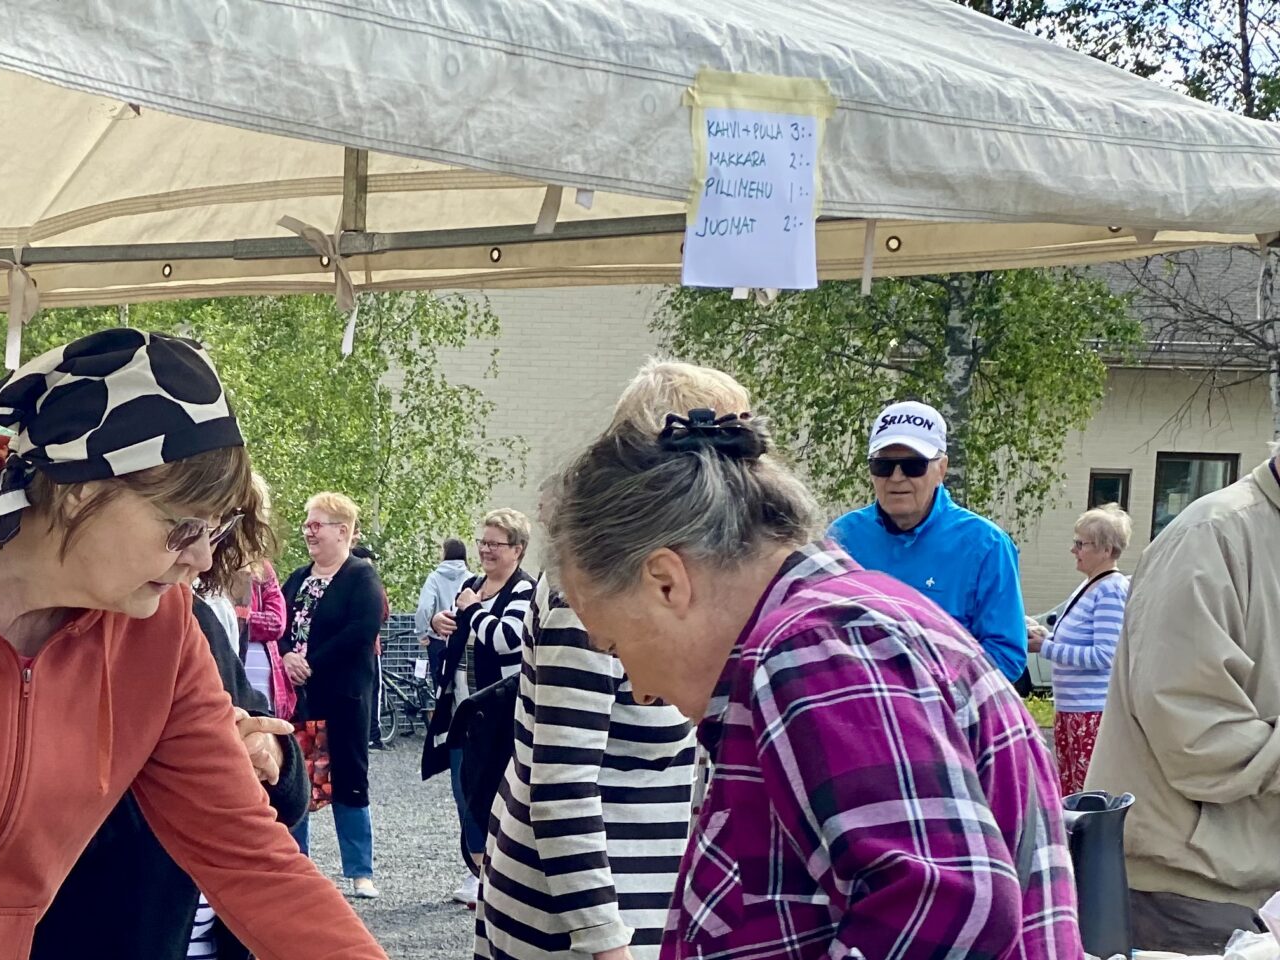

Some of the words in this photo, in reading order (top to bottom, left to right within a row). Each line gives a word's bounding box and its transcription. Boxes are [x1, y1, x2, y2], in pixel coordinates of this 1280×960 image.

[709, 150, 766, 168] MAKKARA
[705, 177, 773, 200] PILLIMEHU
[695, 216, 757, 238] JUOMAT
[876, 414, 935, 435] SRIXON
